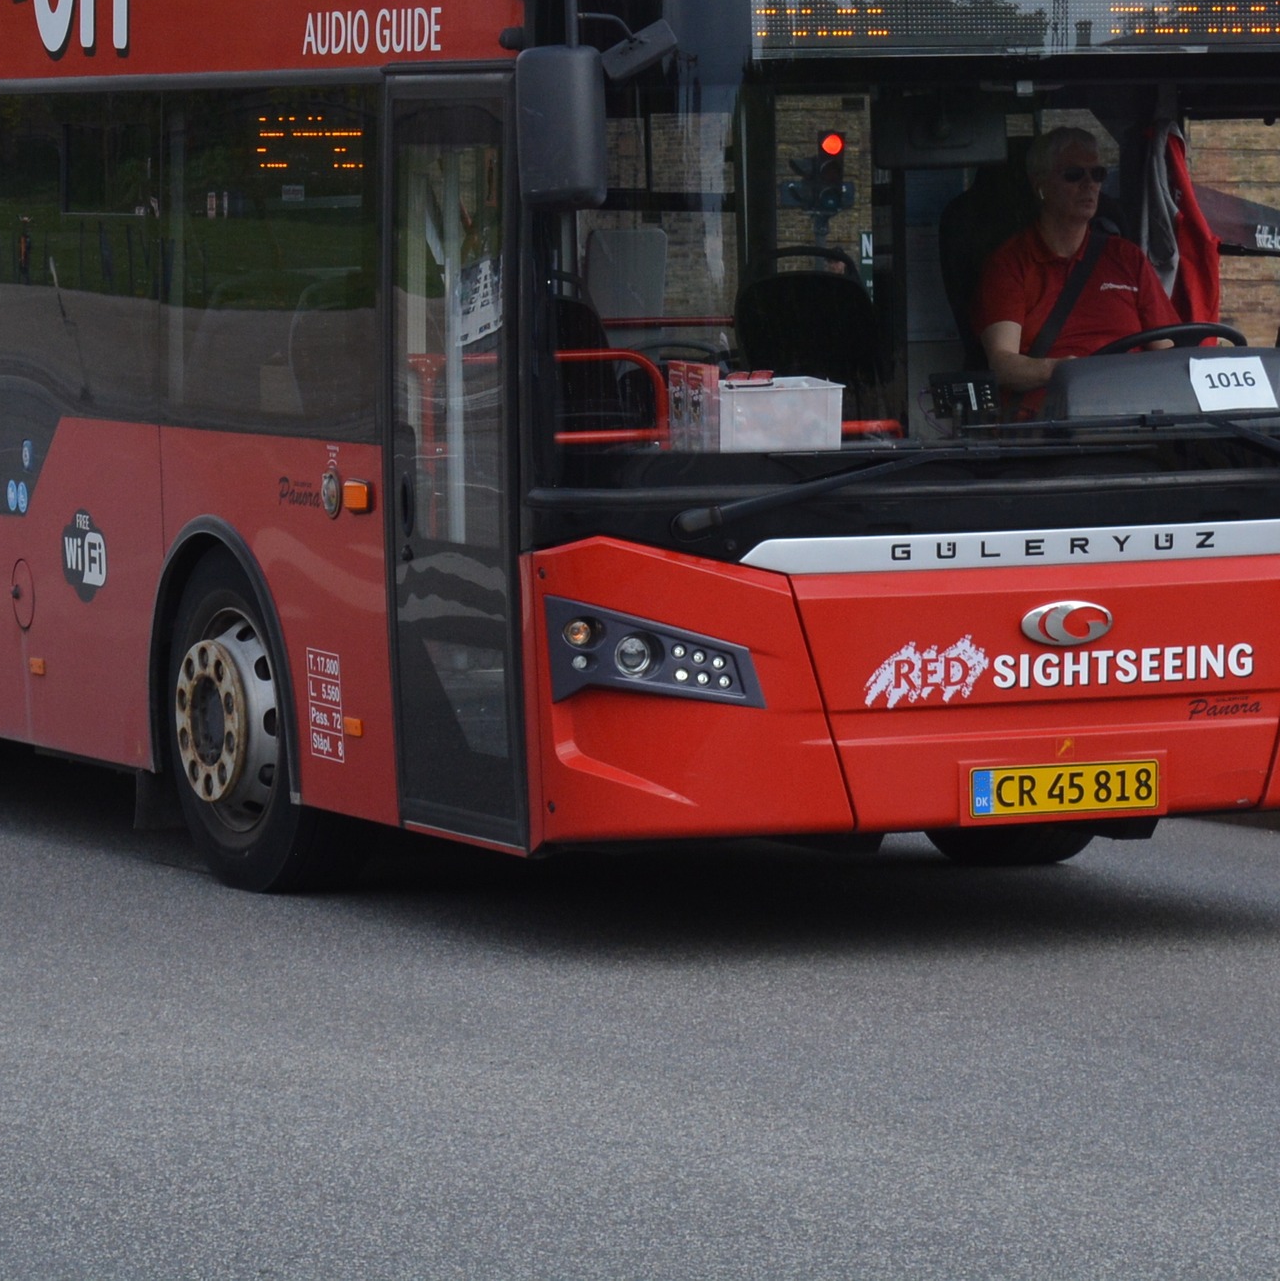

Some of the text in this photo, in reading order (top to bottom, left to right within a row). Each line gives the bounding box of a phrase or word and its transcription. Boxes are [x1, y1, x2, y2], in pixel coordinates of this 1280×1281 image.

[302, 7, 442, 55] AUDIO GUIDE
[1204, 371, 1256, 390] 1016
[76, 513, 90, 530] FREE
[890, 531, 1215, 561] GÜLERYÜZ
[992, 642, 1254, 689] SIGHTSEEING
[311, 706, 342, 729] Pass. 72
[1188, 698, 1263, 720] Panora
[337, 741, 343, 757] 8
[995, 767, 1153, 808] CR 45 818
[975, 796, 989, 808] DK
